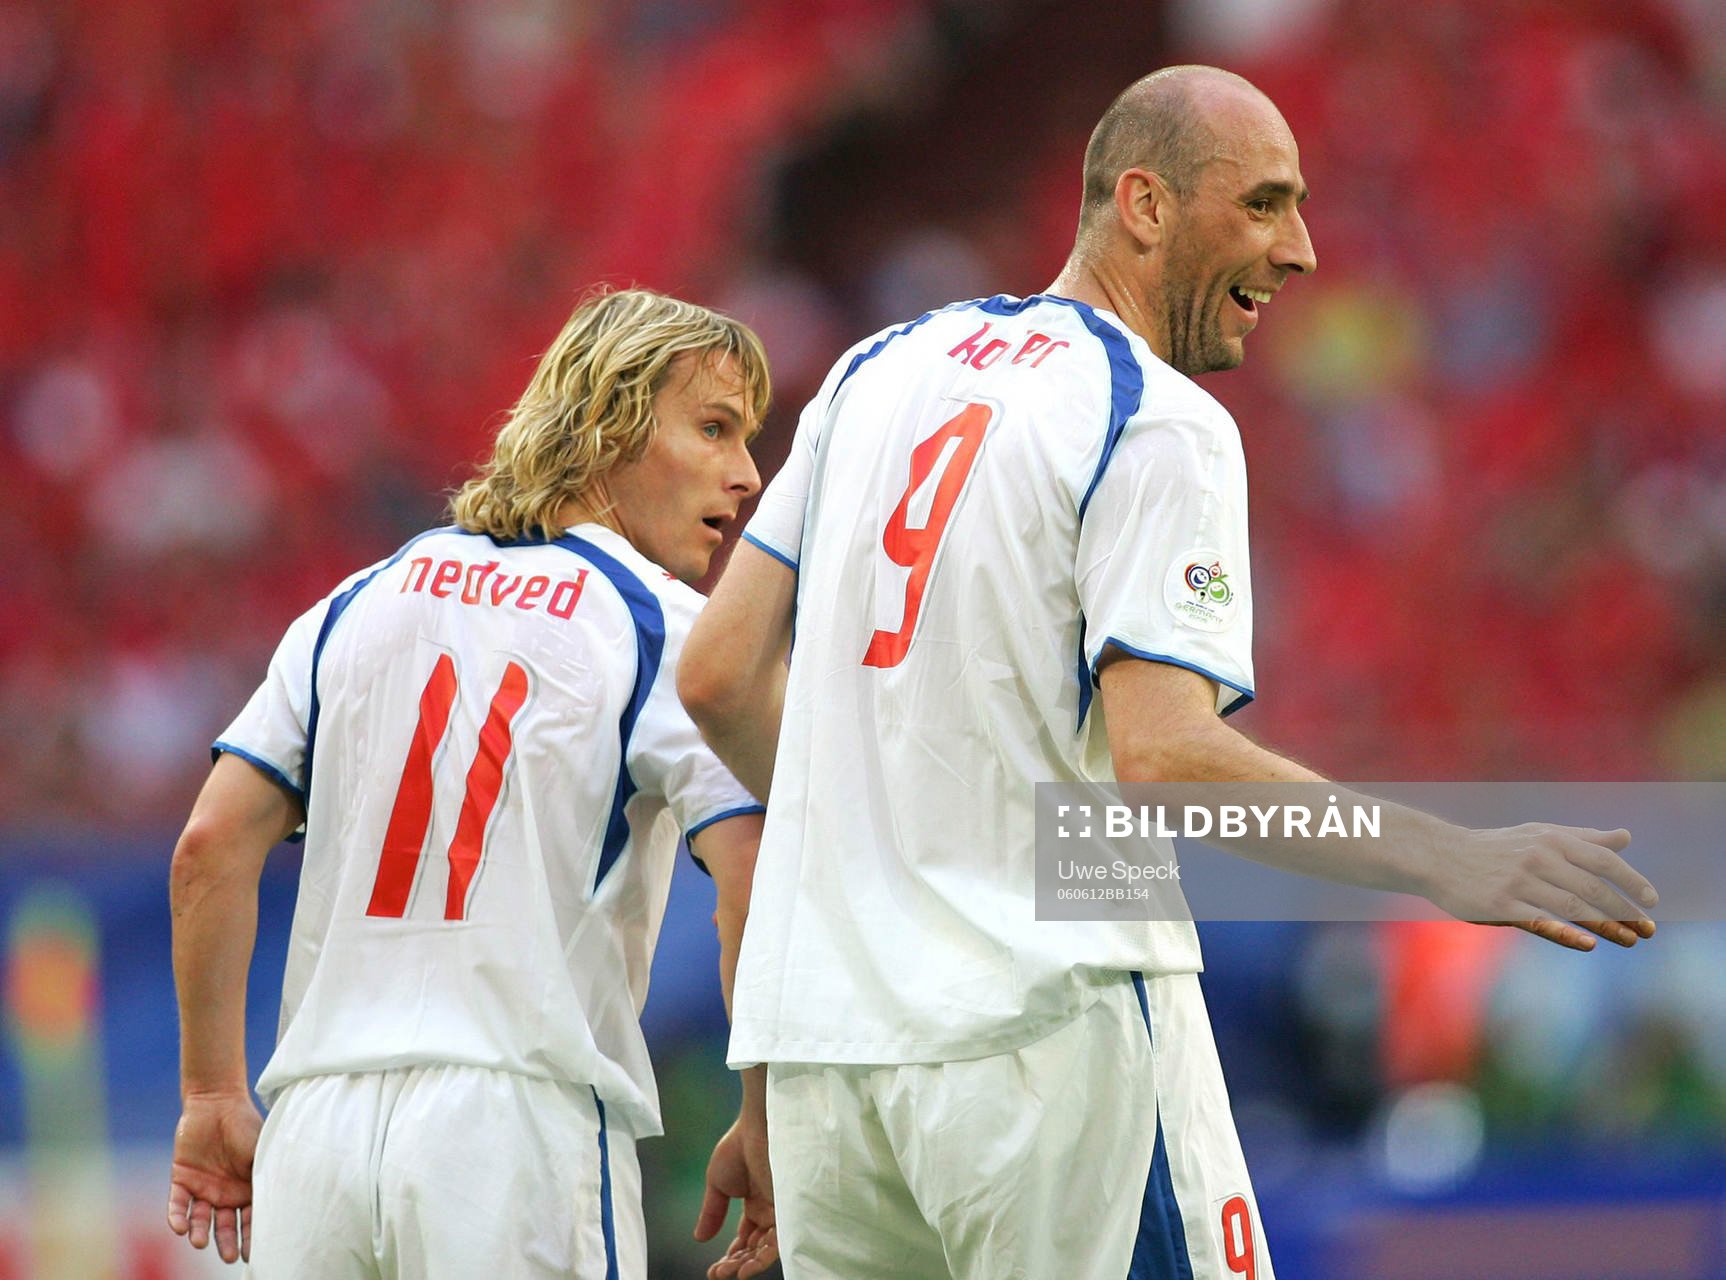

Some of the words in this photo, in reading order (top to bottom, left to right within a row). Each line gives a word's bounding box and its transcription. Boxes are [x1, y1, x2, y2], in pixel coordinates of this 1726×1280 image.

[400, 556, 590, 621] nedved
[861, 402, 993, 669] 9
[365, 652, 529, 921] 11
[1221, 1196, 1256, 1280] 9
